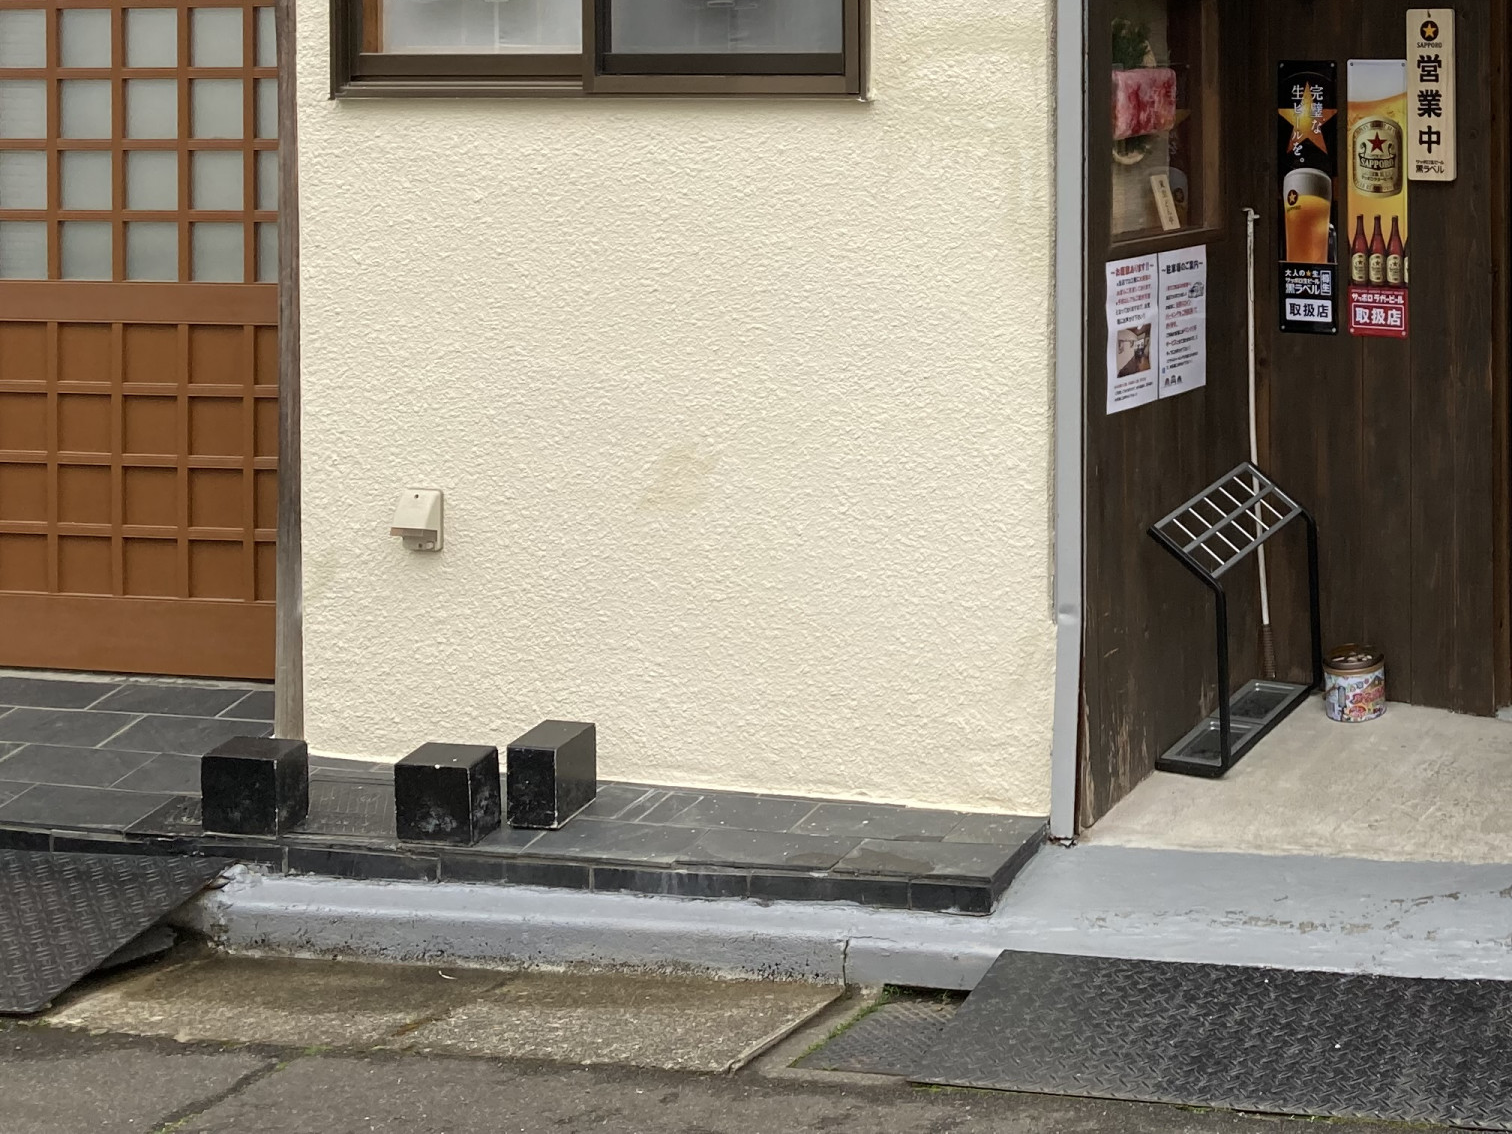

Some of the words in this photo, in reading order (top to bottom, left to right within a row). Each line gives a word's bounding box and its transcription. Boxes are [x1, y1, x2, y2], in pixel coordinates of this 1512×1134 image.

[1310, 85, 1323, 134] 完璧な
[1417, 54, 1442, 154] 営業中
[1360, 157, 1394, 169] SAPPORO
[1416, 165, 1444, 174] 黒ラベル
[1285, 283, 1320, 295] 黒ラベル
[1289, 302, 1329, 318] 取扱店
[1355, 307, 1401, 326] 取扱店
